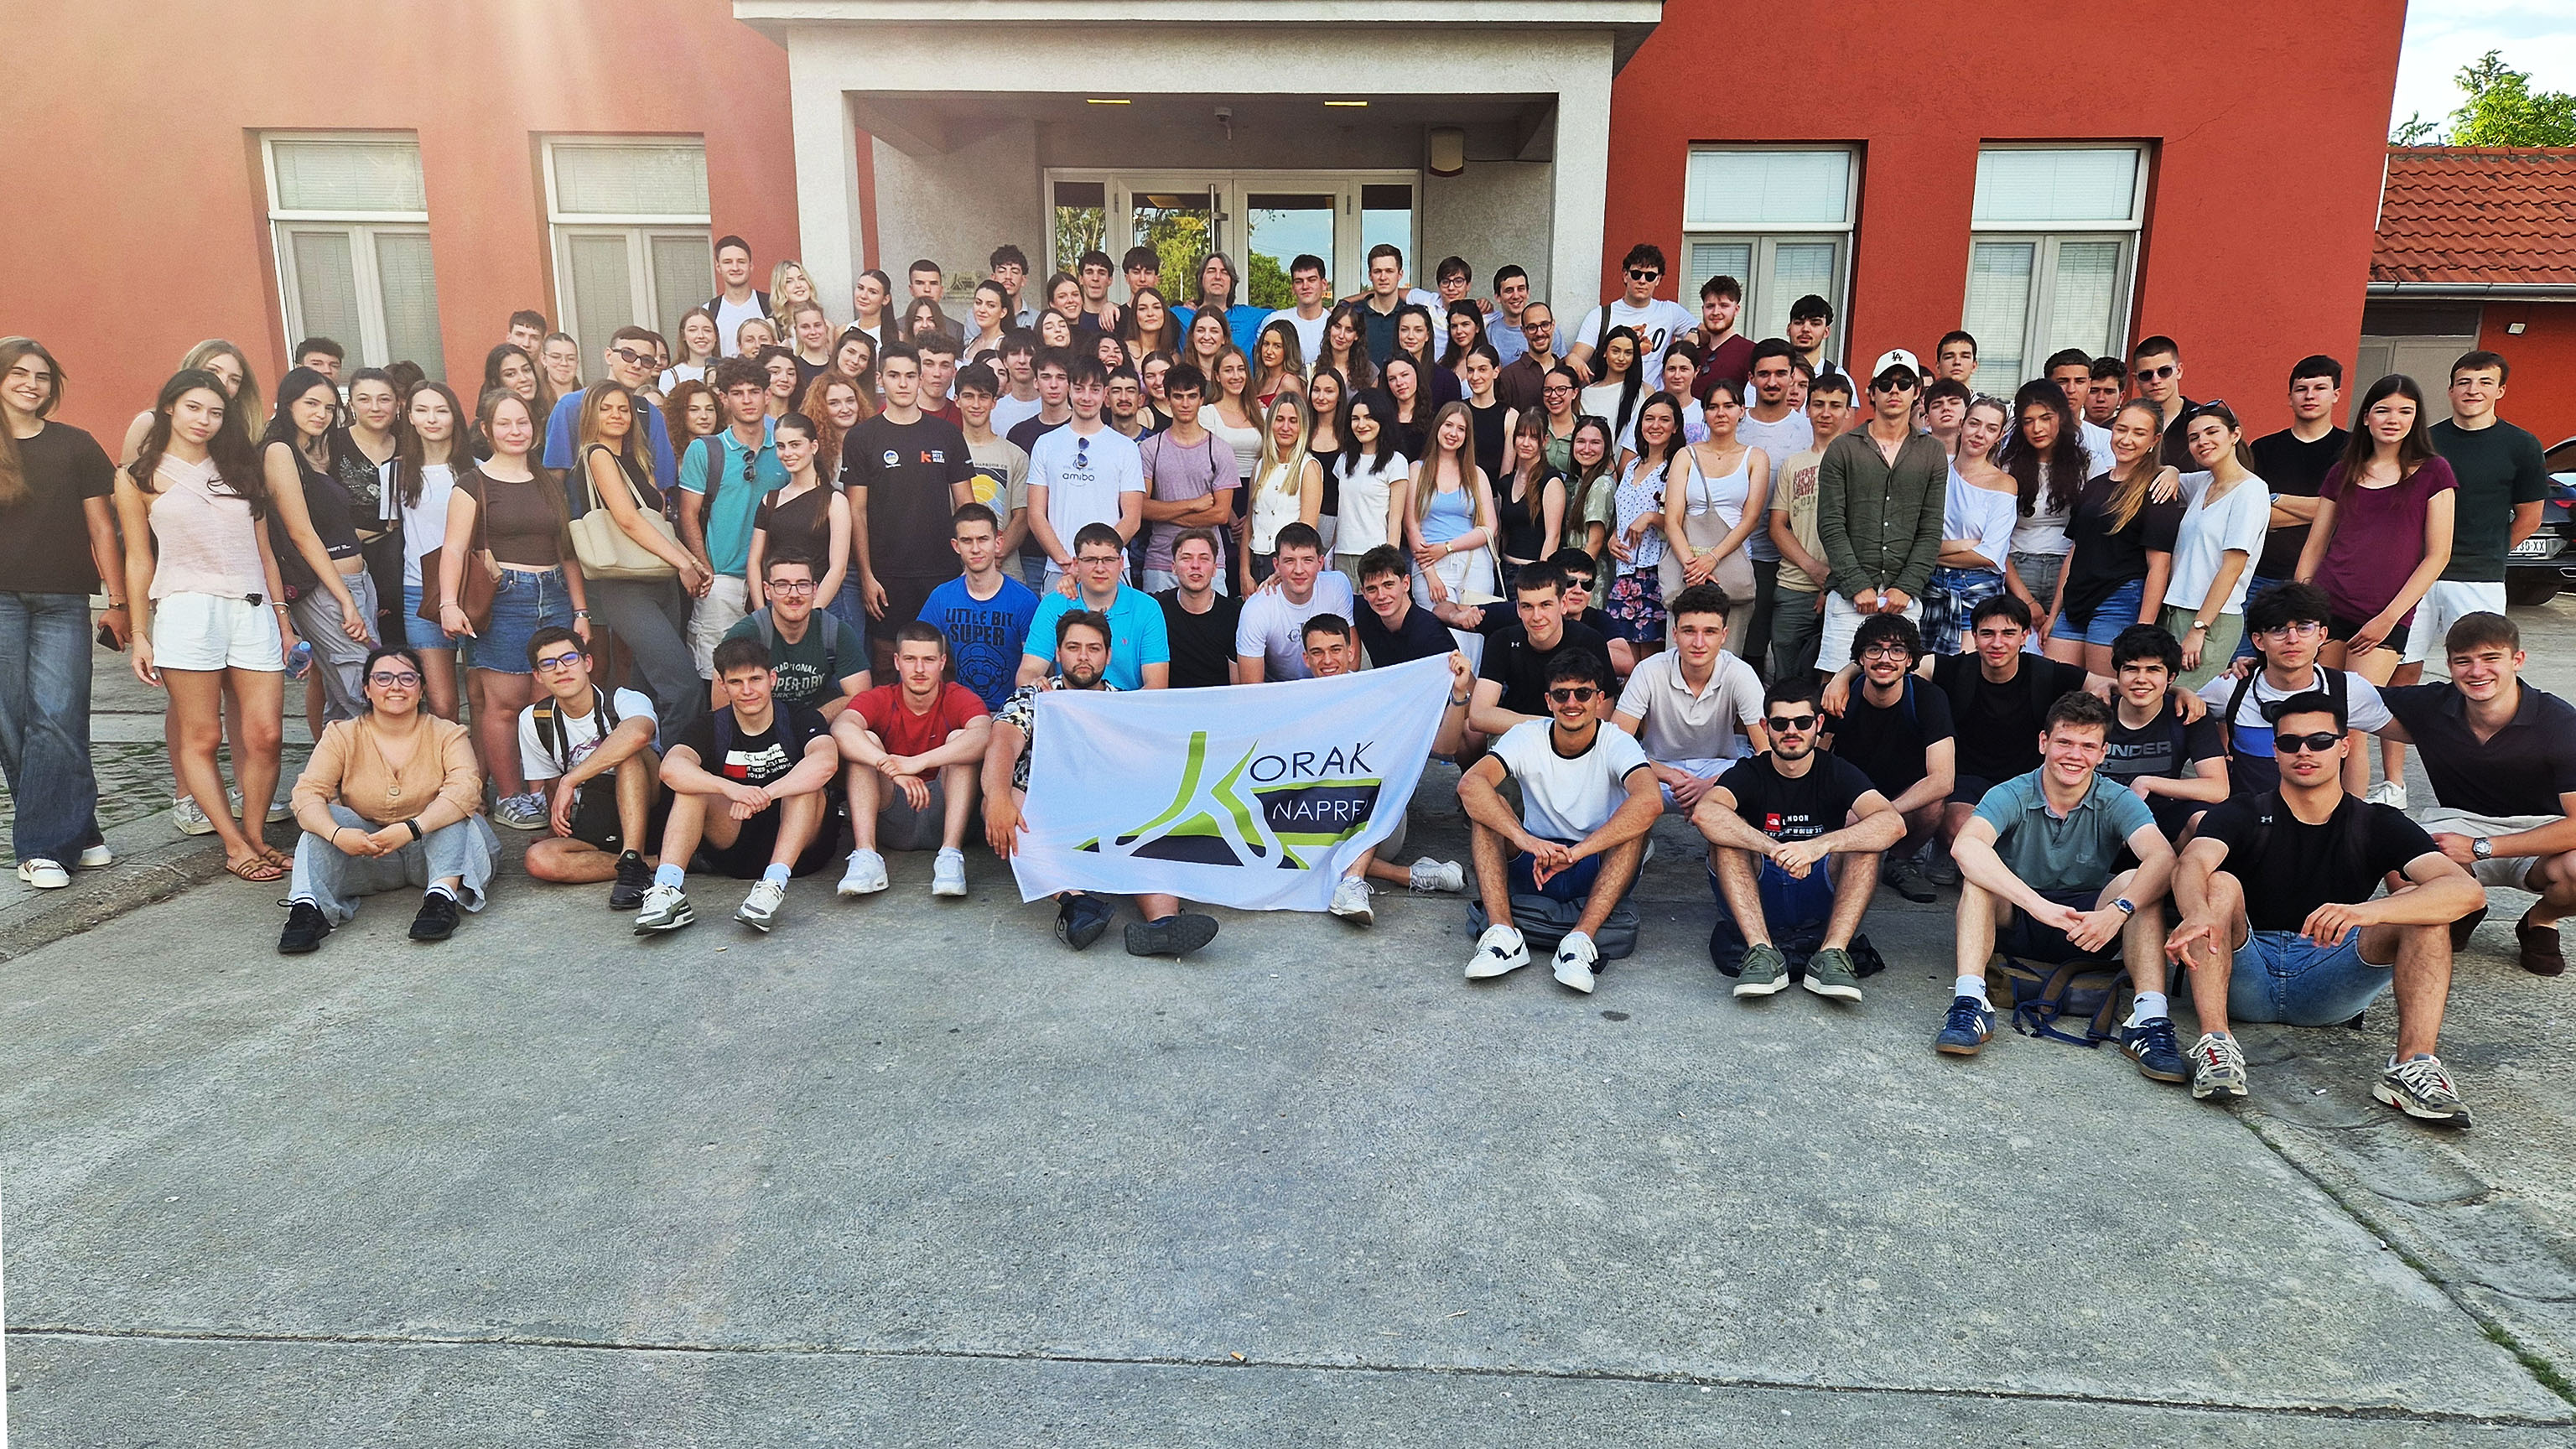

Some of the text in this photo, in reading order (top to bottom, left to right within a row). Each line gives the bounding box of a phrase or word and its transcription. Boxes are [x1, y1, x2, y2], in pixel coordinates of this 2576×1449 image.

[1892, 351, 1903, 361] LA
[1062, 473, 1095, 481] amibo
[945, 608, 1013, 627] LITTLE BIT
[949, 624, 1005, 646] SUPER
[1272, 799, 1368, 822] NAPRE
[1783, 814, 1809, 825] LNDON
